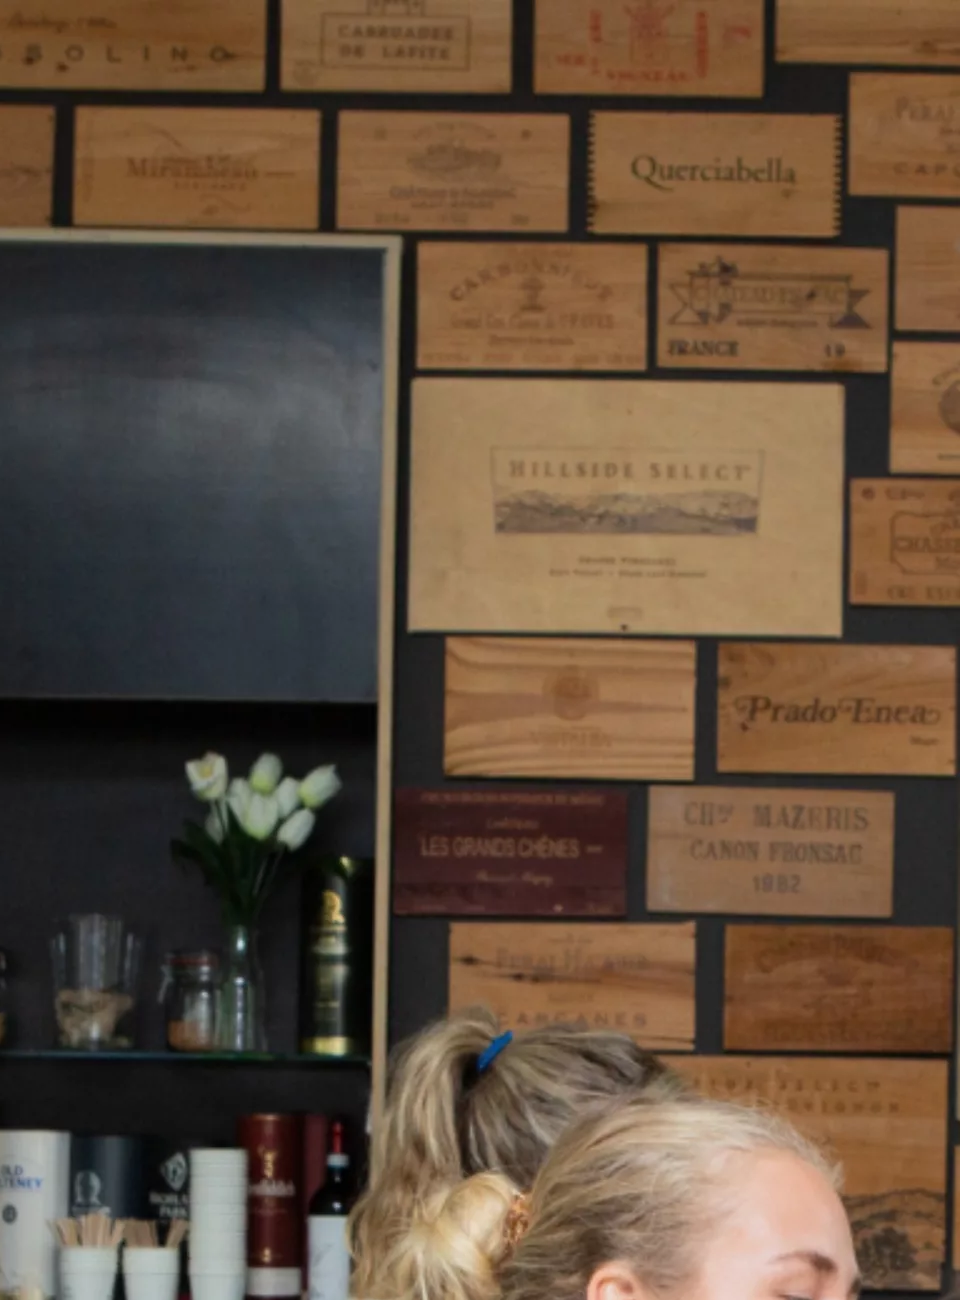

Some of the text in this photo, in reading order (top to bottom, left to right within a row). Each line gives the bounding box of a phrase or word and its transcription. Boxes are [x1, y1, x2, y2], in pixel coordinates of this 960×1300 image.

[630, 154, 797, 193] Querciabella
[667, 338, 740, 358] FRANCE
[507, 459, 750, 482] HILLSIDE SELECT
[734, 694, 941, 726] Prado Enea
[752, 803, 871, 832] MAZERIS
[419, 836, 450, 858] LES
[452, 836, 516, 859] GRANDS
[689, 838, 864, 866] CANON FRONSAC
